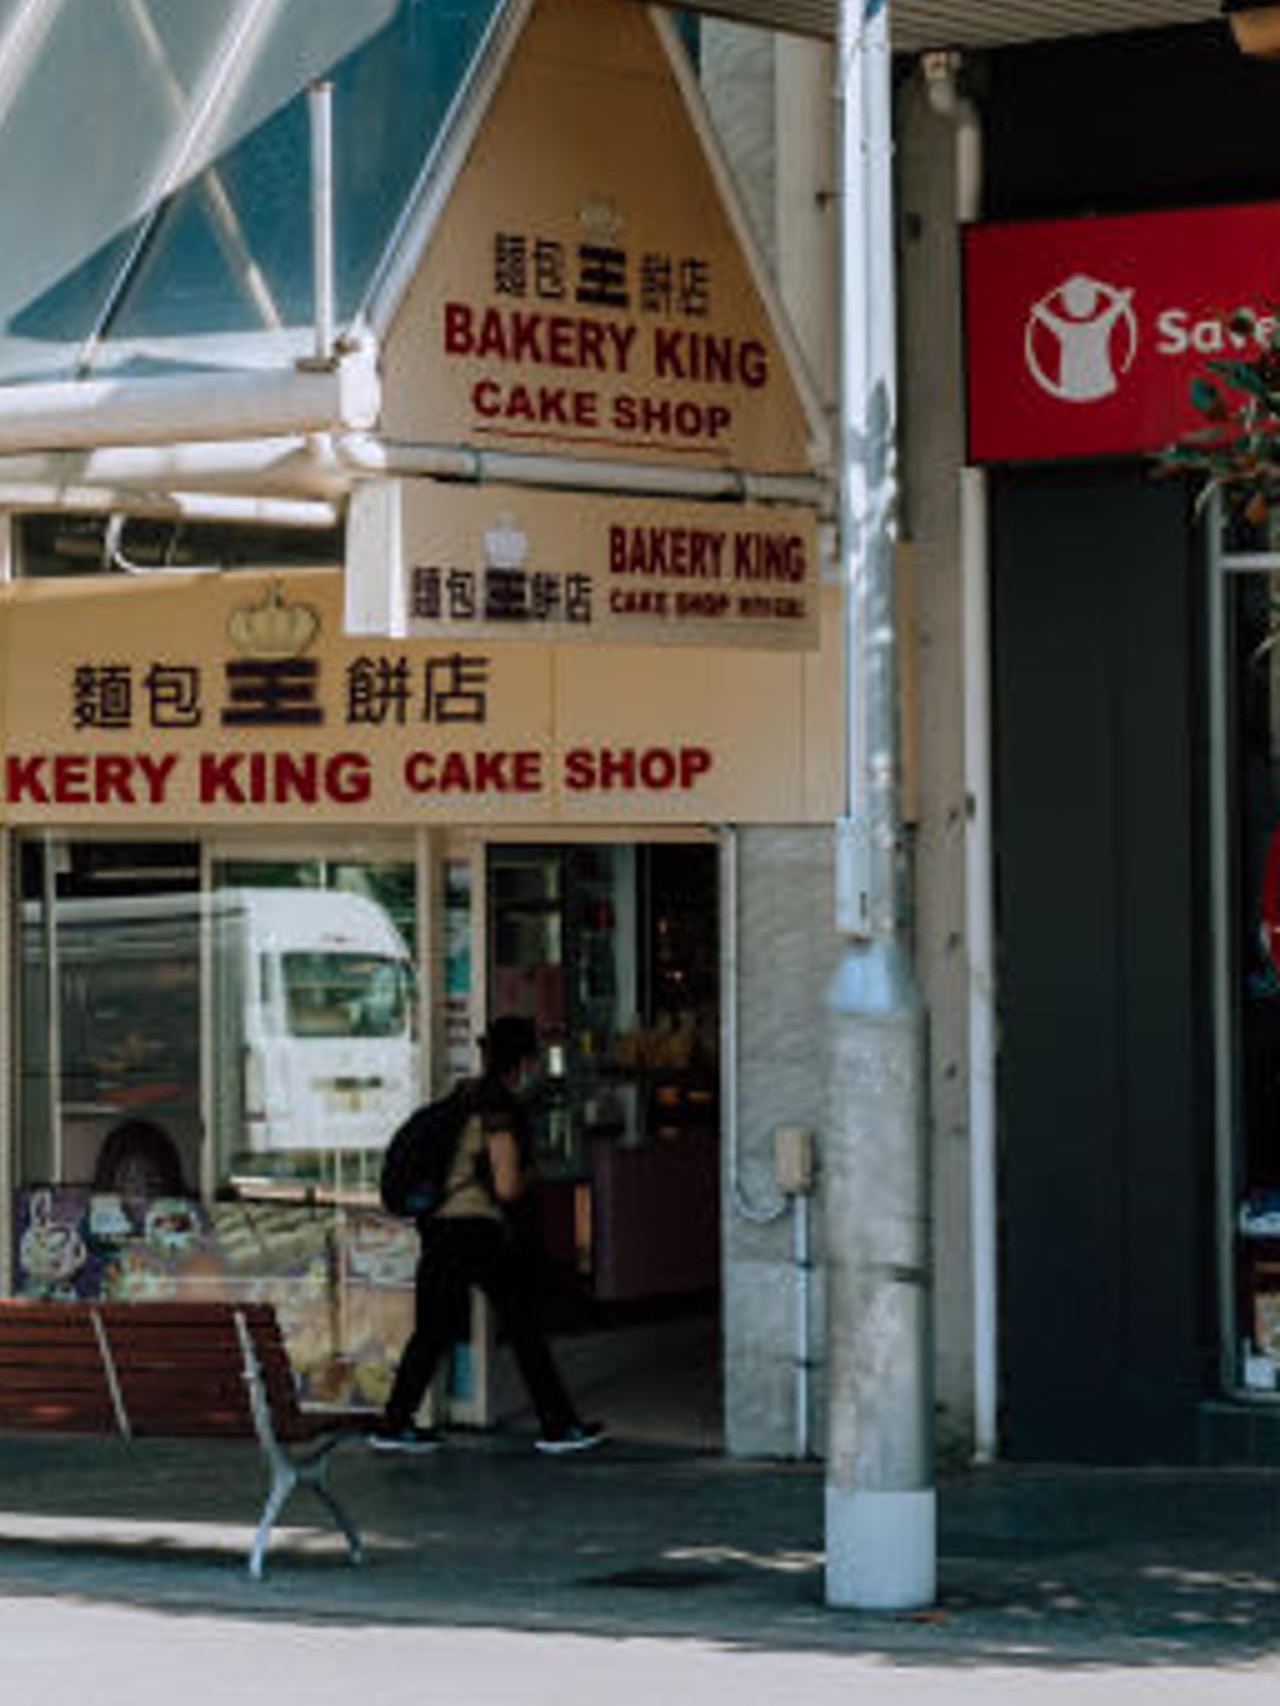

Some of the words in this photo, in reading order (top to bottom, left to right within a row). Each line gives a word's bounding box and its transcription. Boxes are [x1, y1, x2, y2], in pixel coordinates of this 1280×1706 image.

[443, 302, 638, 373] BAKERY
[654, 327, 768, 389] KING
[471, 379, 598, 427] CAKE
[612, 397, 732, 439] SHOP
[609, 525, 726, 578] BAKERY
[734, 532, 807, 583] KING
[72, 652, 490, 731] 麵包王餅店
[198, 750, 372, 805] KING
[404, 750, 543, 793] CAKE
[563, 747, 712, 791] SHOP
